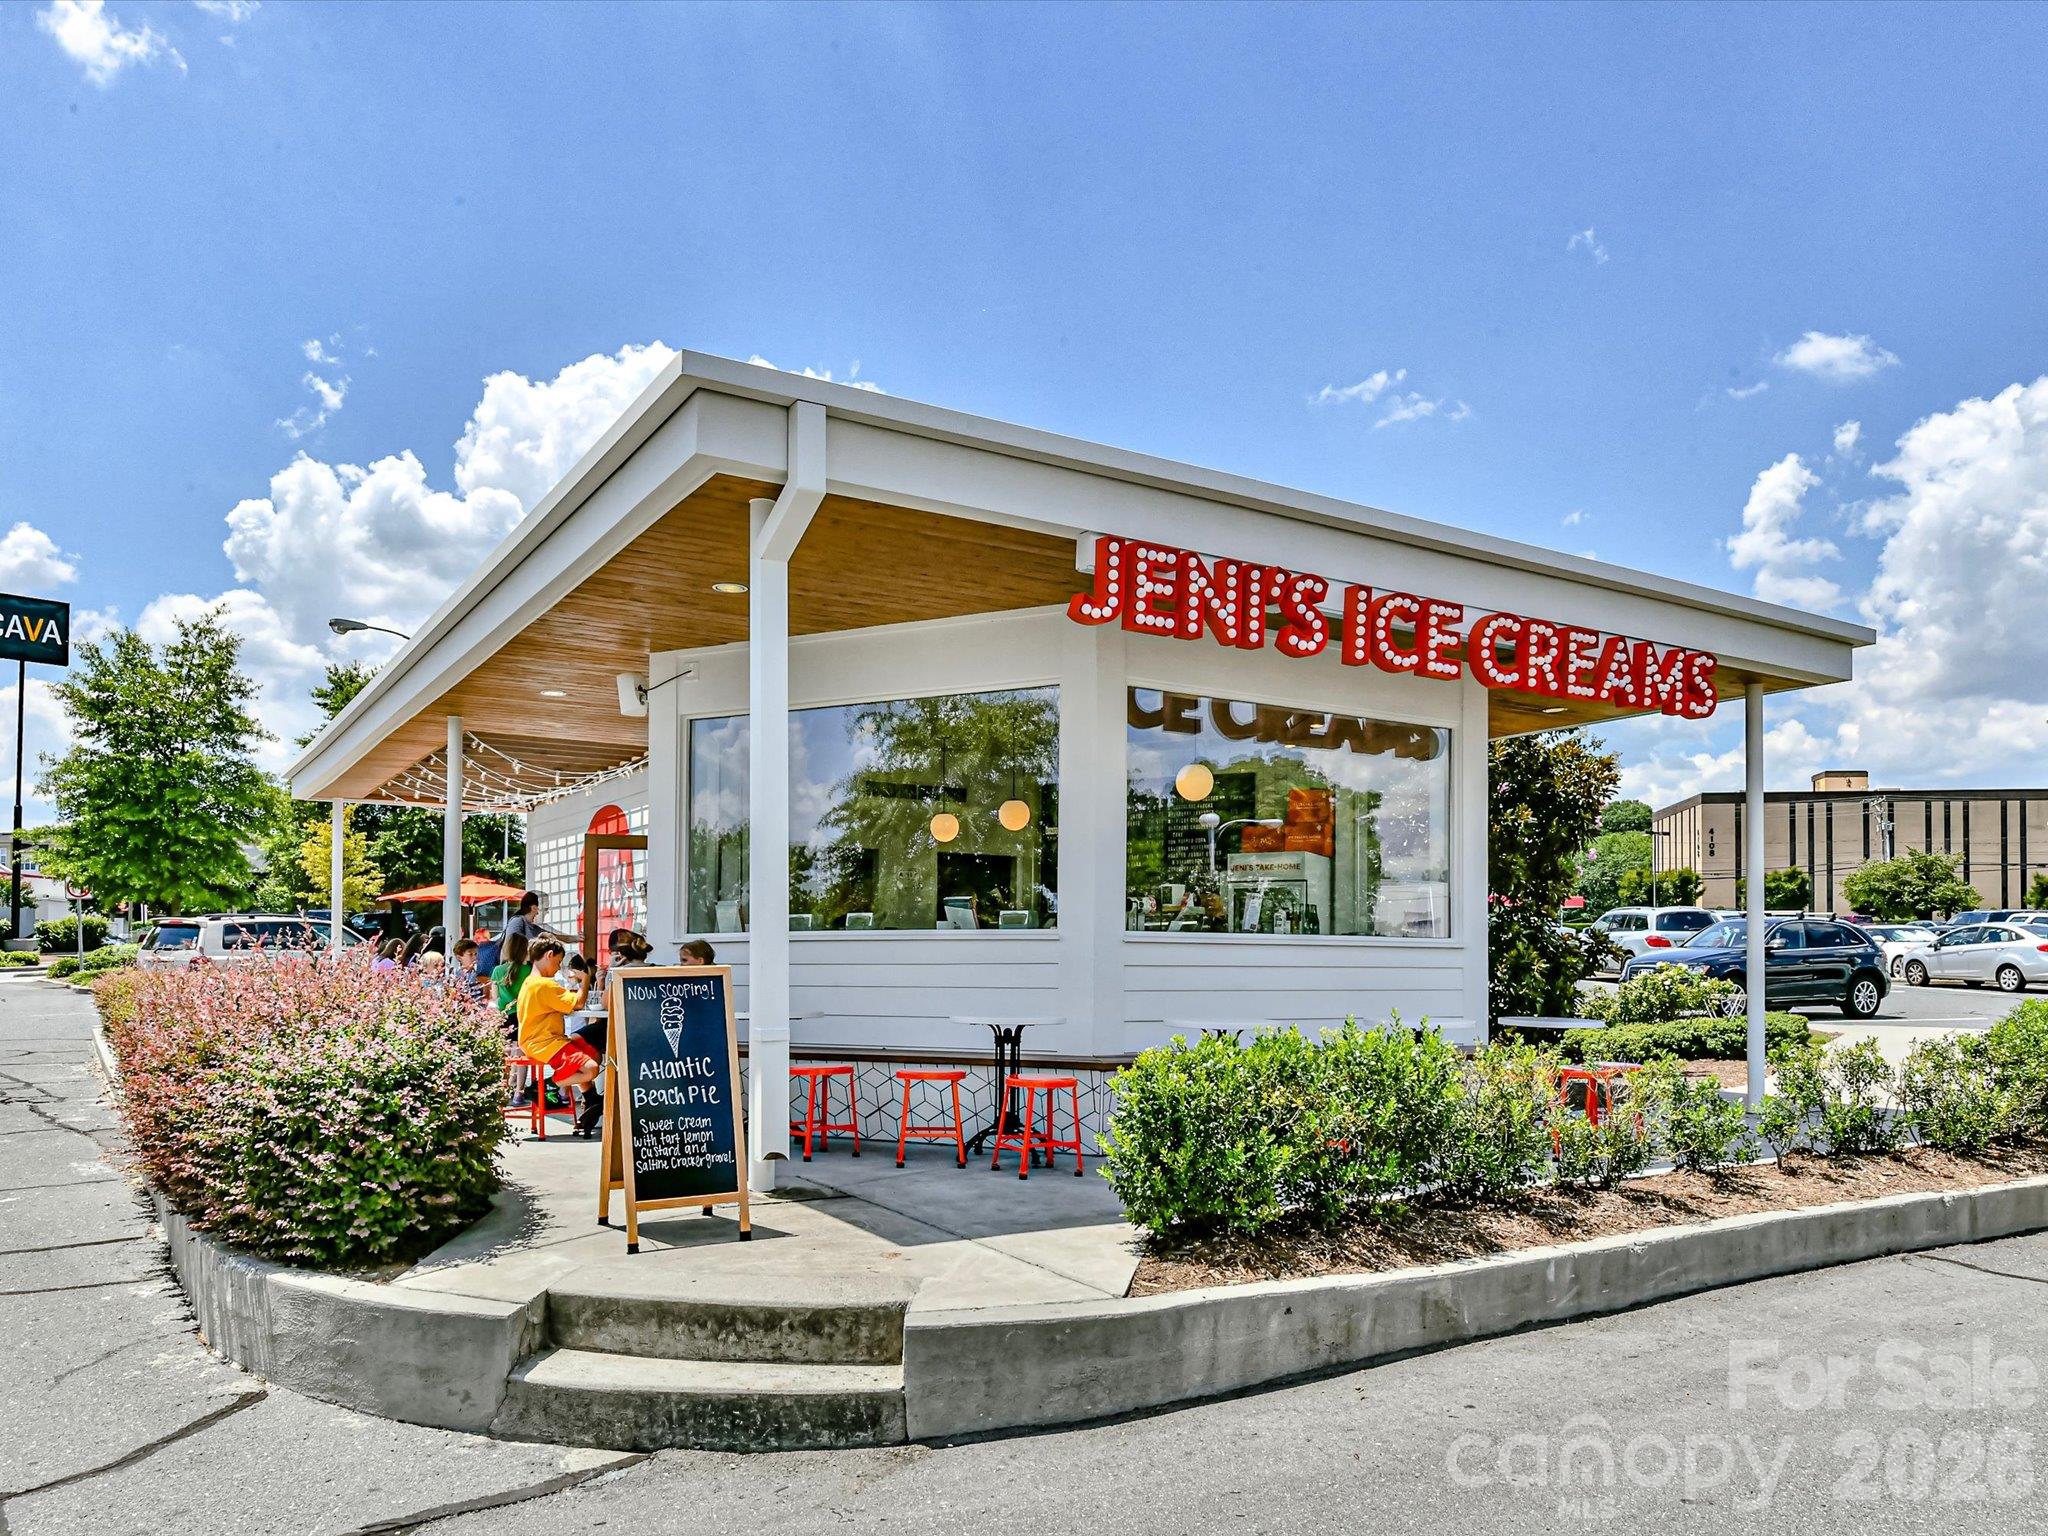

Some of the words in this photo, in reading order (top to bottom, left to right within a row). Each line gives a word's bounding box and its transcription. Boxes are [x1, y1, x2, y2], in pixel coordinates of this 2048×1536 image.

[0, 613, 62, 645] AVA
[1067, 534, 1330, 658] JENI'S
[1341, 584, 1464, 681] ICE
[1468, 612, 1719, 720] CREAMS
[627, 985, 657, 1000] NOW
[633, 1086, 686, 1108] Beach
[688, 1085, 720, 1104] Pie
[639, 1118, 674, 1134] Sweet
[633, 1133, 657, 1147] with
[660, 1132, 680, 1145] tart
[683, 1130, 714, 1143] lemon
[684, 1142, 707, 1155] and
[636, 1158, 669, 1173] Saltine
